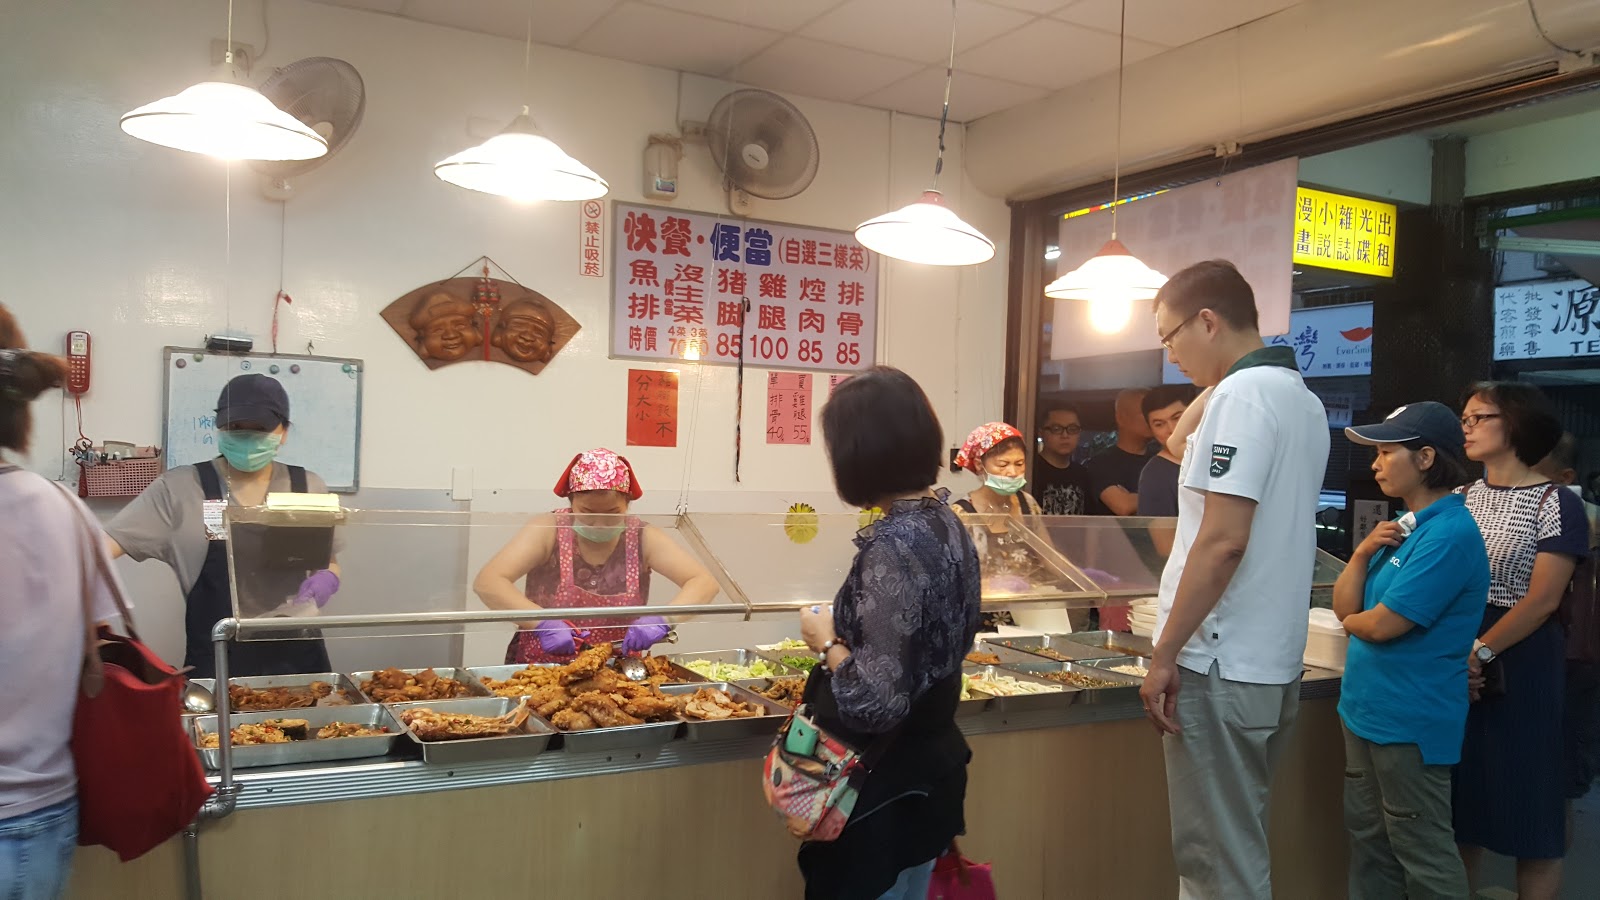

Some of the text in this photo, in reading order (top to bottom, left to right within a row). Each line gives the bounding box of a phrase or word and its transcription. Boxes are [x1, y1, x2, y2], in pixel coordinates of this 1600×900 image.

[584, 221, 600, 275] 禁止吸菸
[1296, 196, 1312, 255] 漫畫
[1336, 204, 1353, 261] 雜誌
[1356, 208, 1373, 264] 光碟
[1377, 212, 1392, 267] 出租
[628, 259, 660, 320] 魚排
[664, 278, 674, 316] 便當
[758, 273, 787, 331] 雞腿
[837, 280, 864, 336] 排骨
[629, 325, 657, 352] 時價
[716, 332, 742, 358] 85
[750, 334, 788, 360] 100
[1499, 292, 1518, 356] 代客煎藥
[1524, 291, 1543, 356] 批發零售
[798, 339, 823, 363] 85
[836, 342, 860, 365] 85
[635, 374, 652, 421] 分大小
[770, 393, 783, 424] 排骨
[1213, 446, 1230, 454] SINYI
